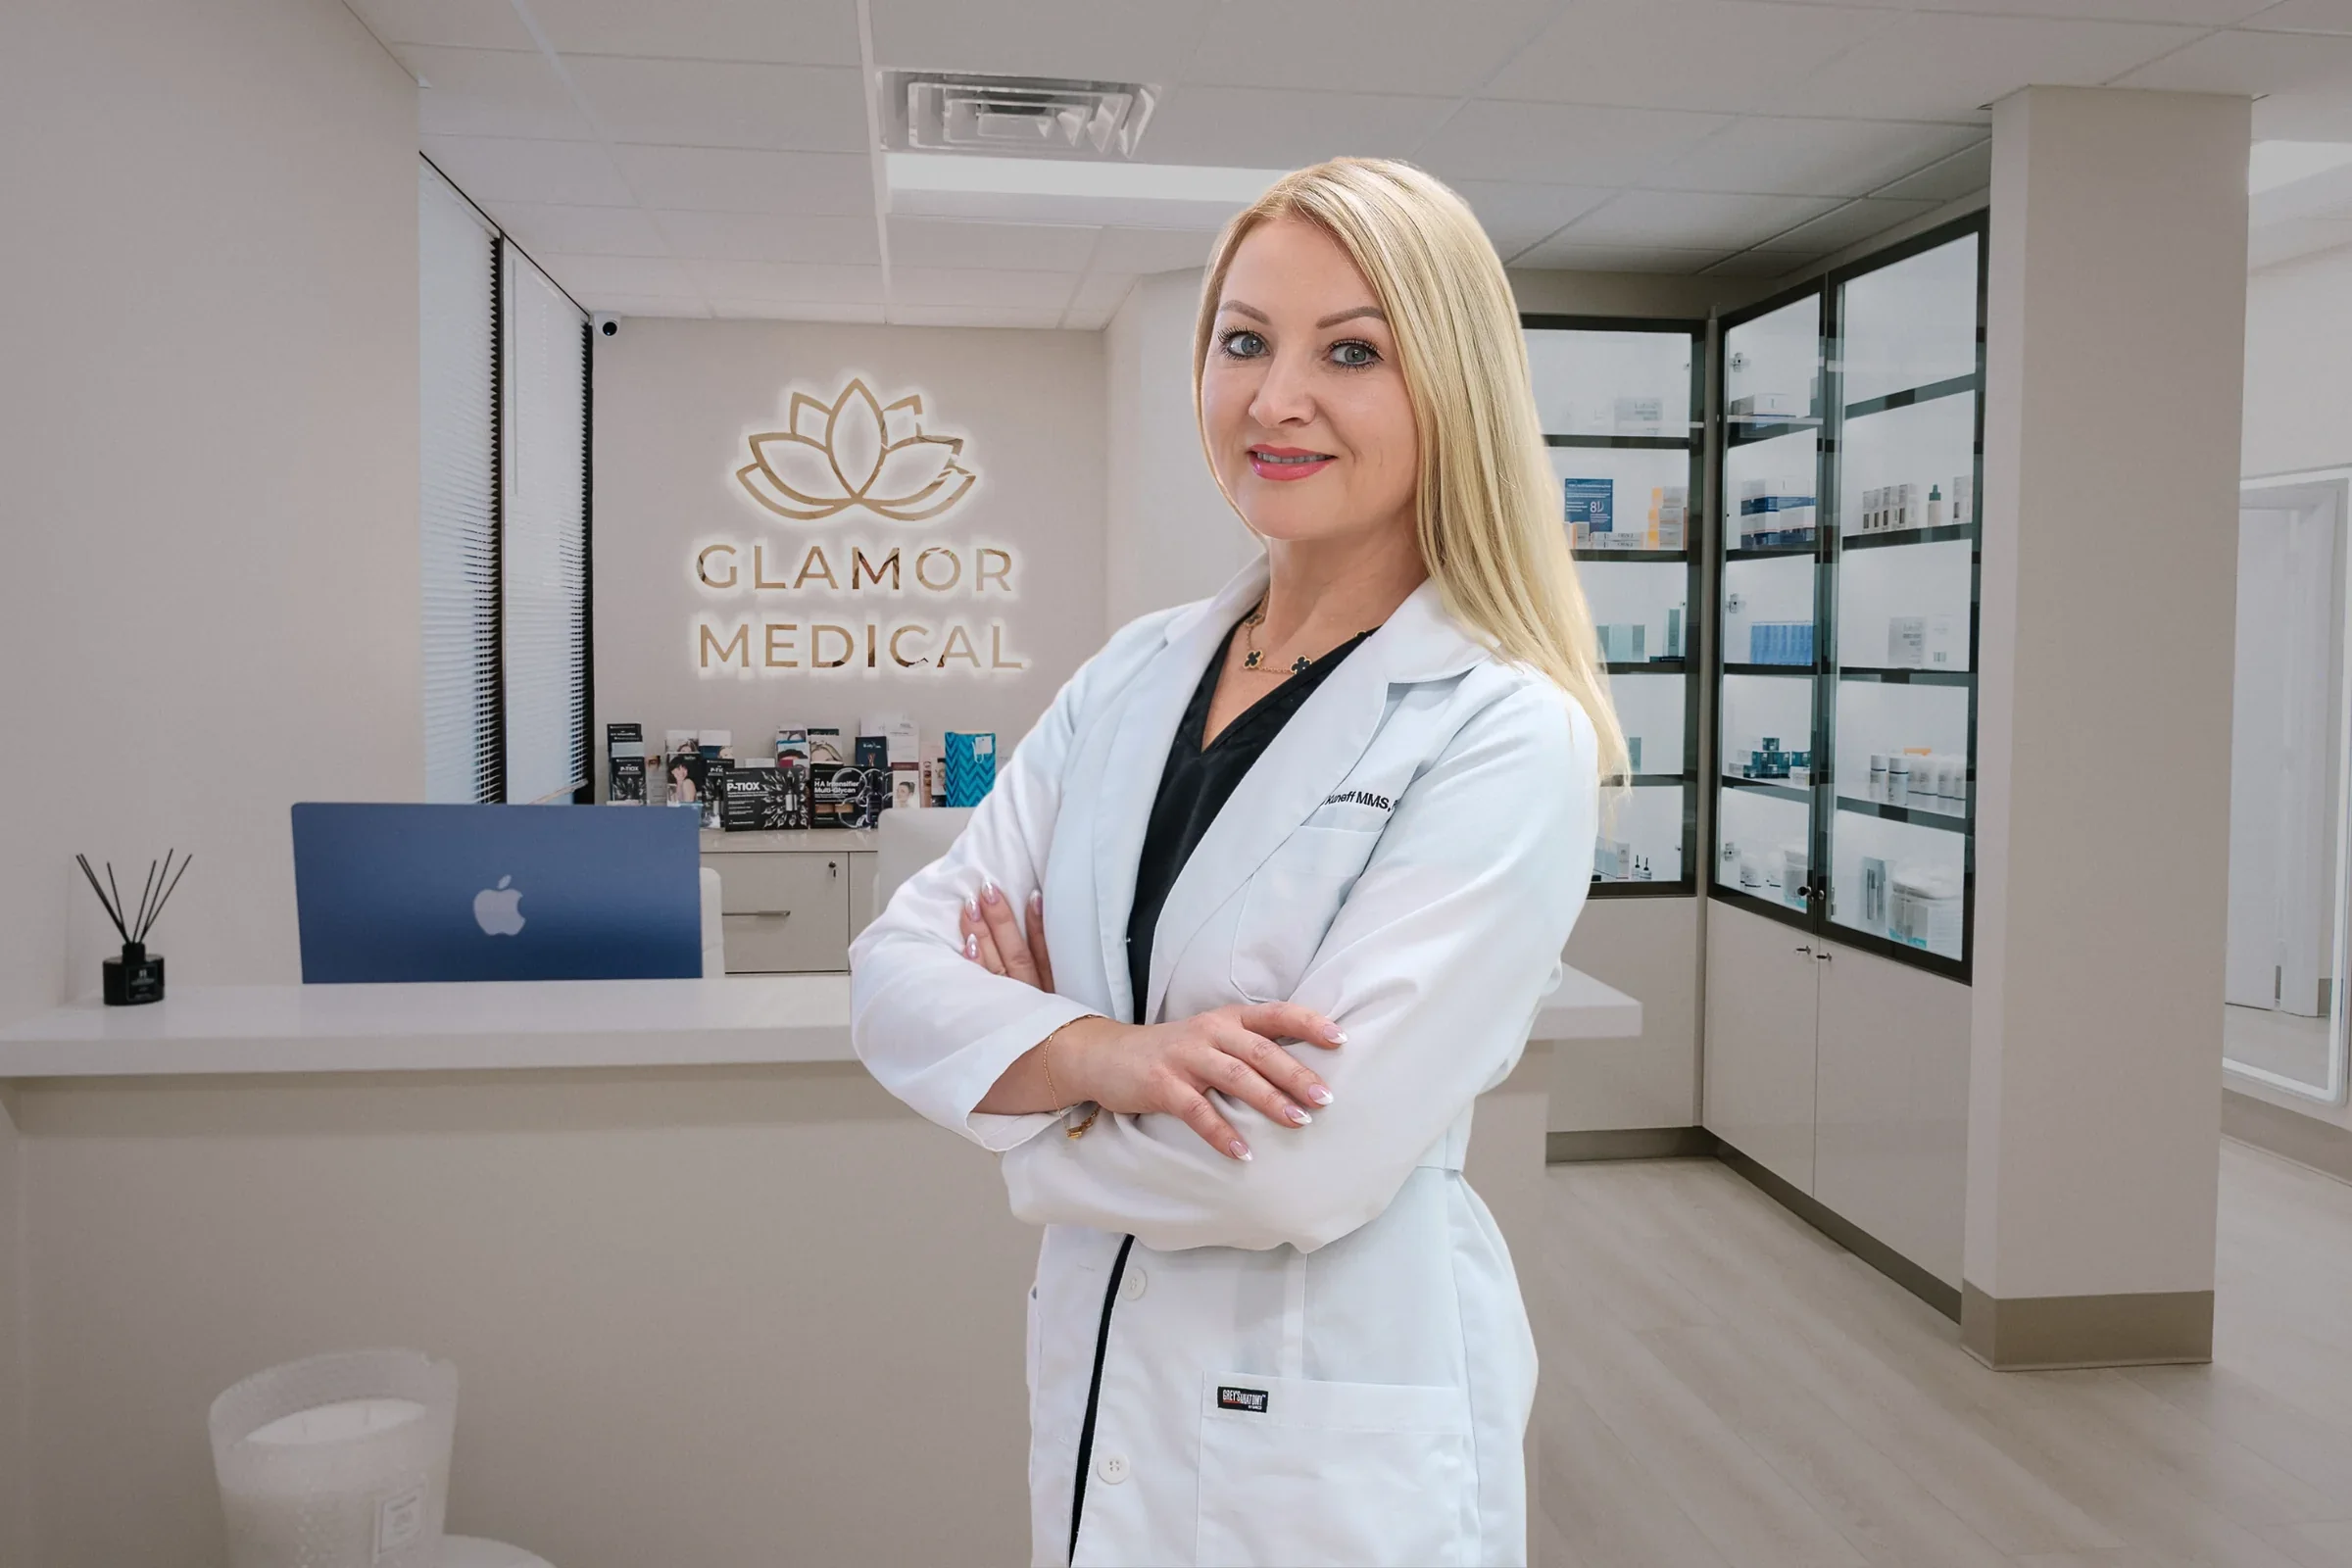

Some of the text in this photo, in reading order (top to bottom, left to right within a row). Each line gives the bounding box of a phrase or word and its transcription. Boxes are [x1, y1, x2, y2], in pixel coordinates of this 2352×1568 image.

[696, 544, 1011, 591] GLAMOR
[700, 623, 1022, 667] MEDICAL
[726, 782, 760, 791] P-TIOX
[1355, 791, 1392, 811] MMS,
